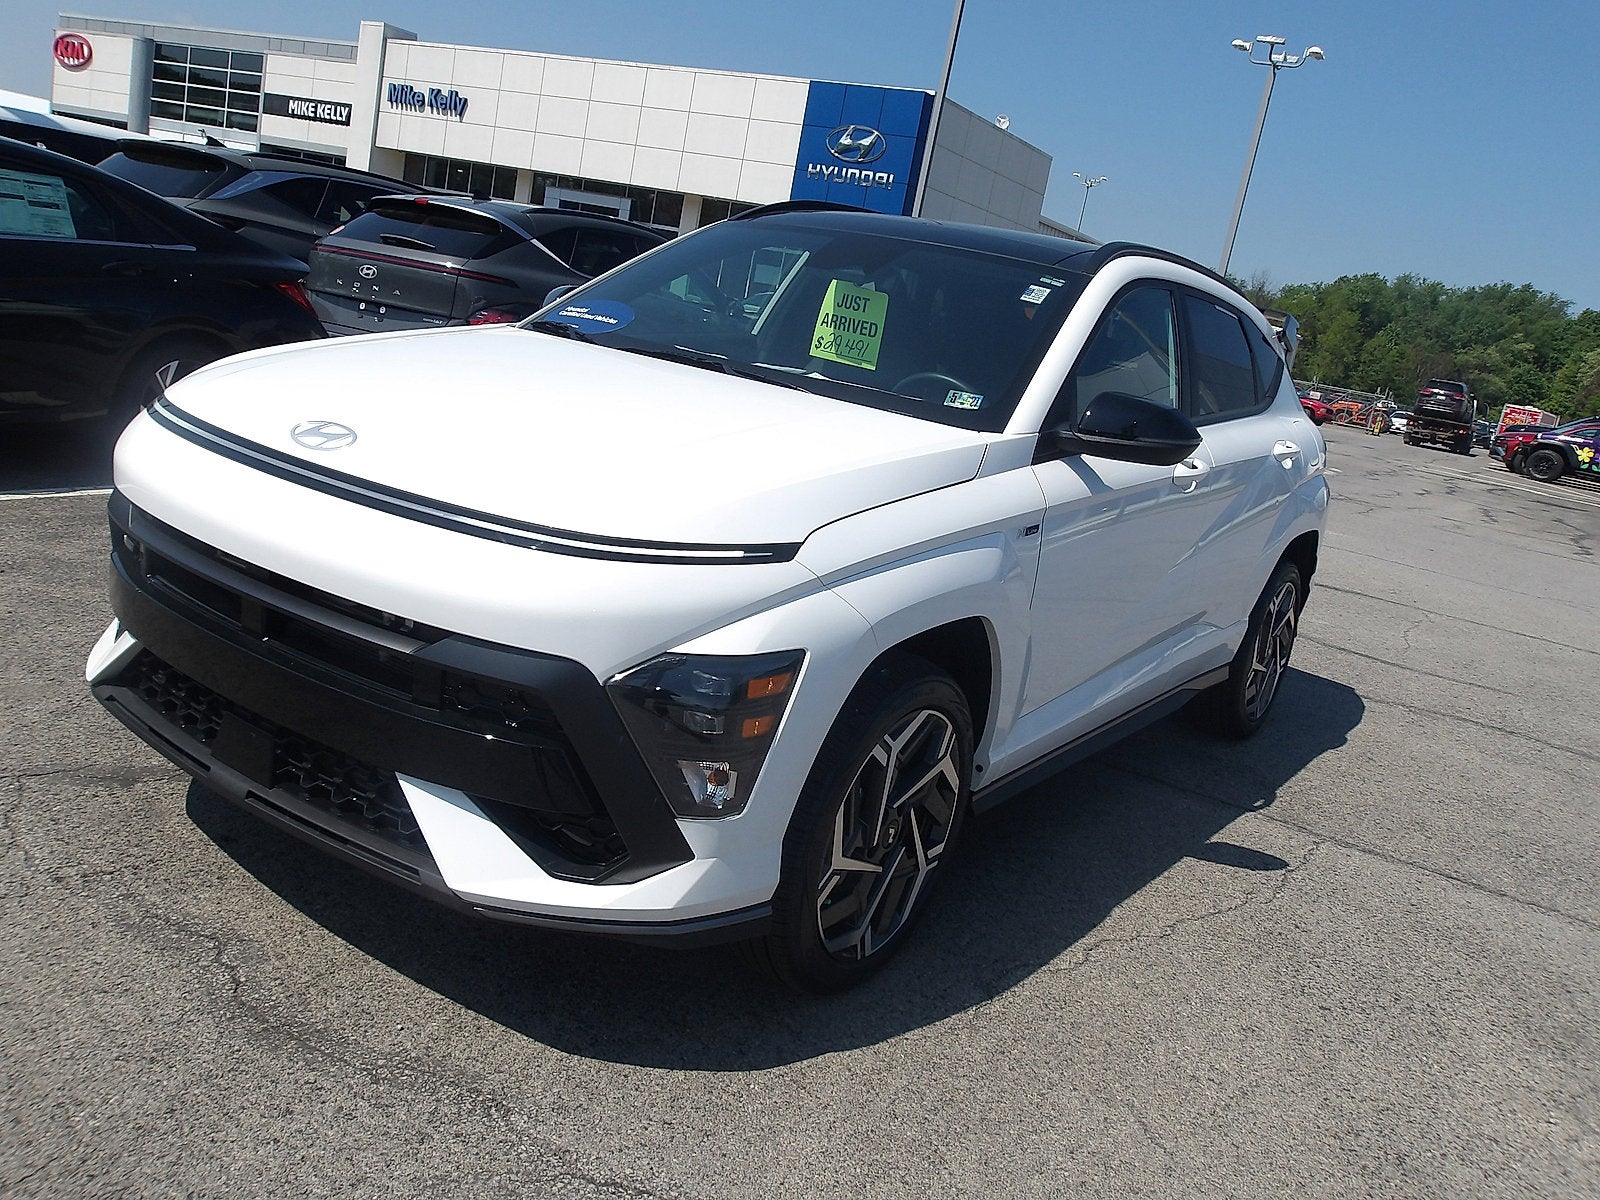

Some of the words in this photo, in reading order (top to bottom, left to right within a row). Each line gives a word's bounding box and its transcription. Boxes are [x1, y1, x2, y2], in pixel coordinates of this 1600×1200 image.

[289, 100, 316, 117] MIKE
[316, 104, 350, 121] KELLY
[387, 83, 425, 107] Mike
[427, 87, 468, 119] Kelly
[807, 163, 895, 190] HYUNDAI
[837, 294, 870, 313] JUST
[820, 312, 879, 338] ARRIVED
